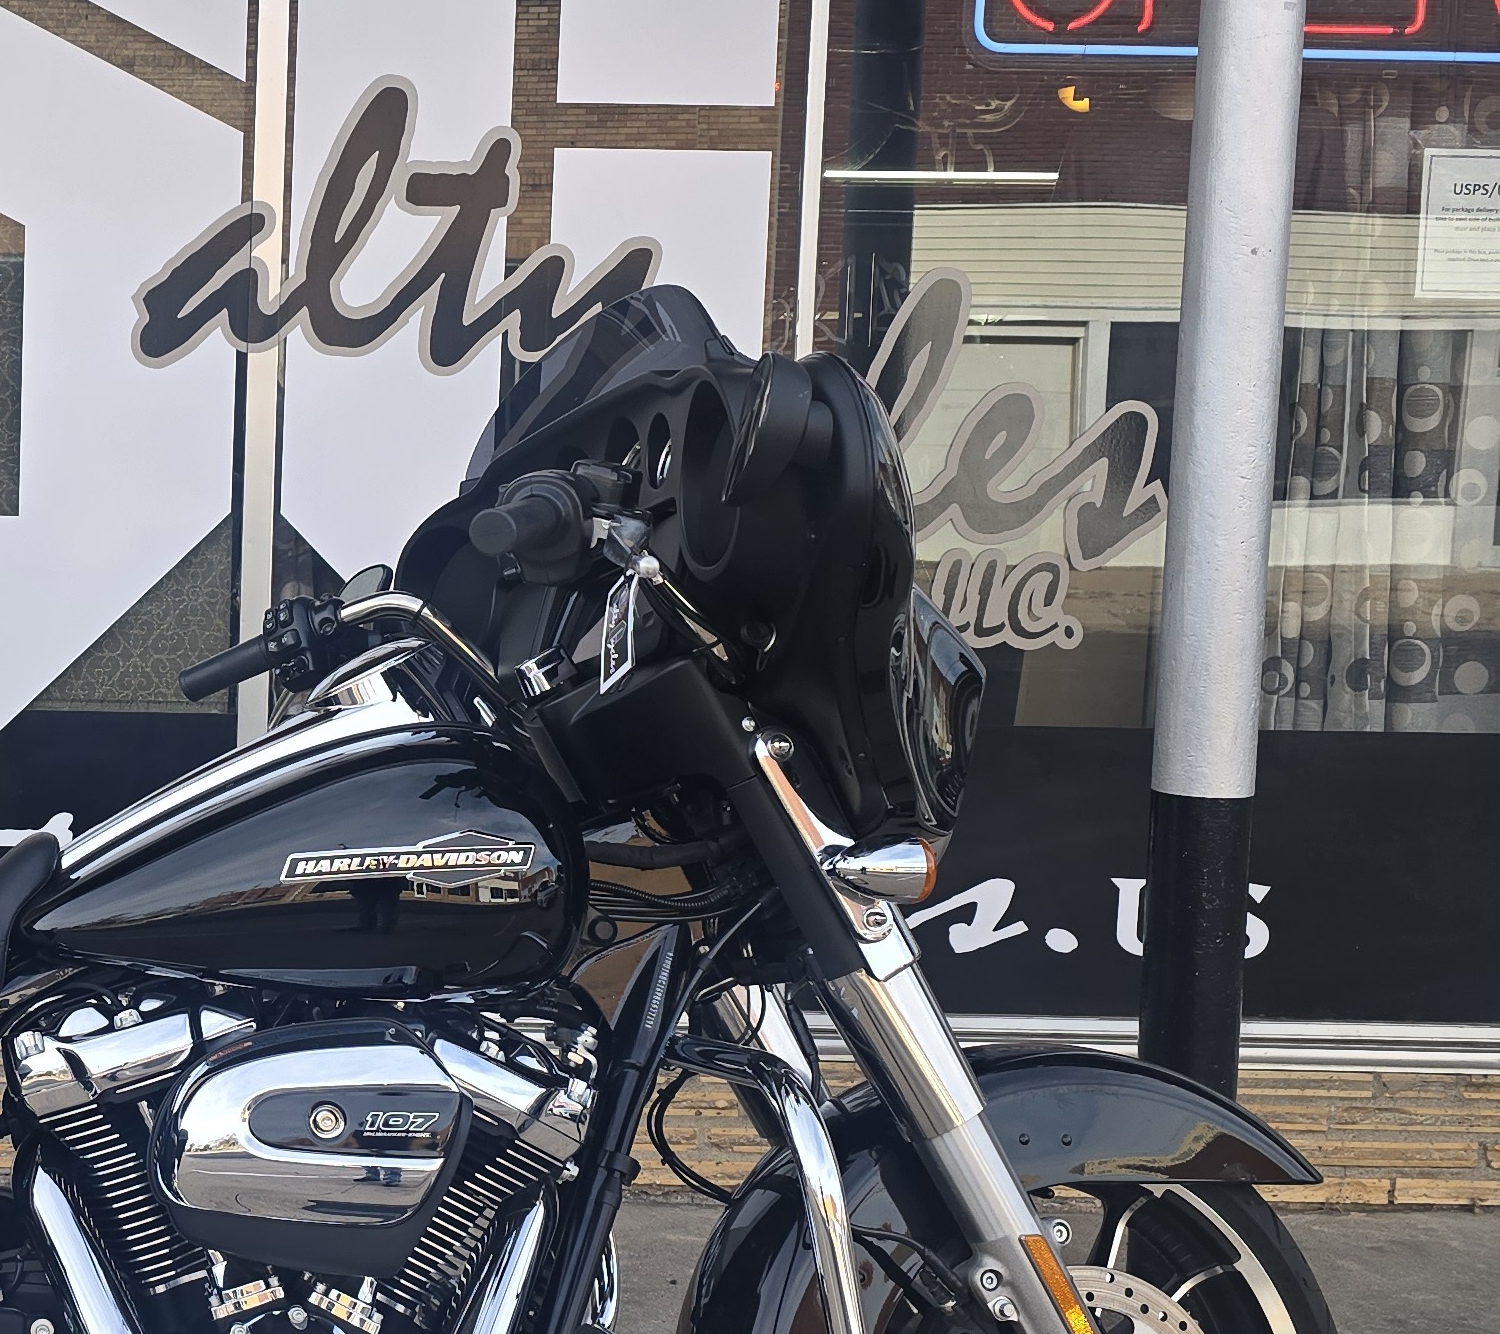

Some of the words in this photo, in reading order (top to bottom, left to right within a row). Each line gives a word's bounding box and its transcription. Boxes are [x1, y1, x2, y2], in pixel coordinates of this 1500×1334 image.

[1453, 182, 1500, 198] USPS/
[294, 849, 525, 876] HARLEY-DAVIDSON
[364, 1110, 441, 1132] 107
